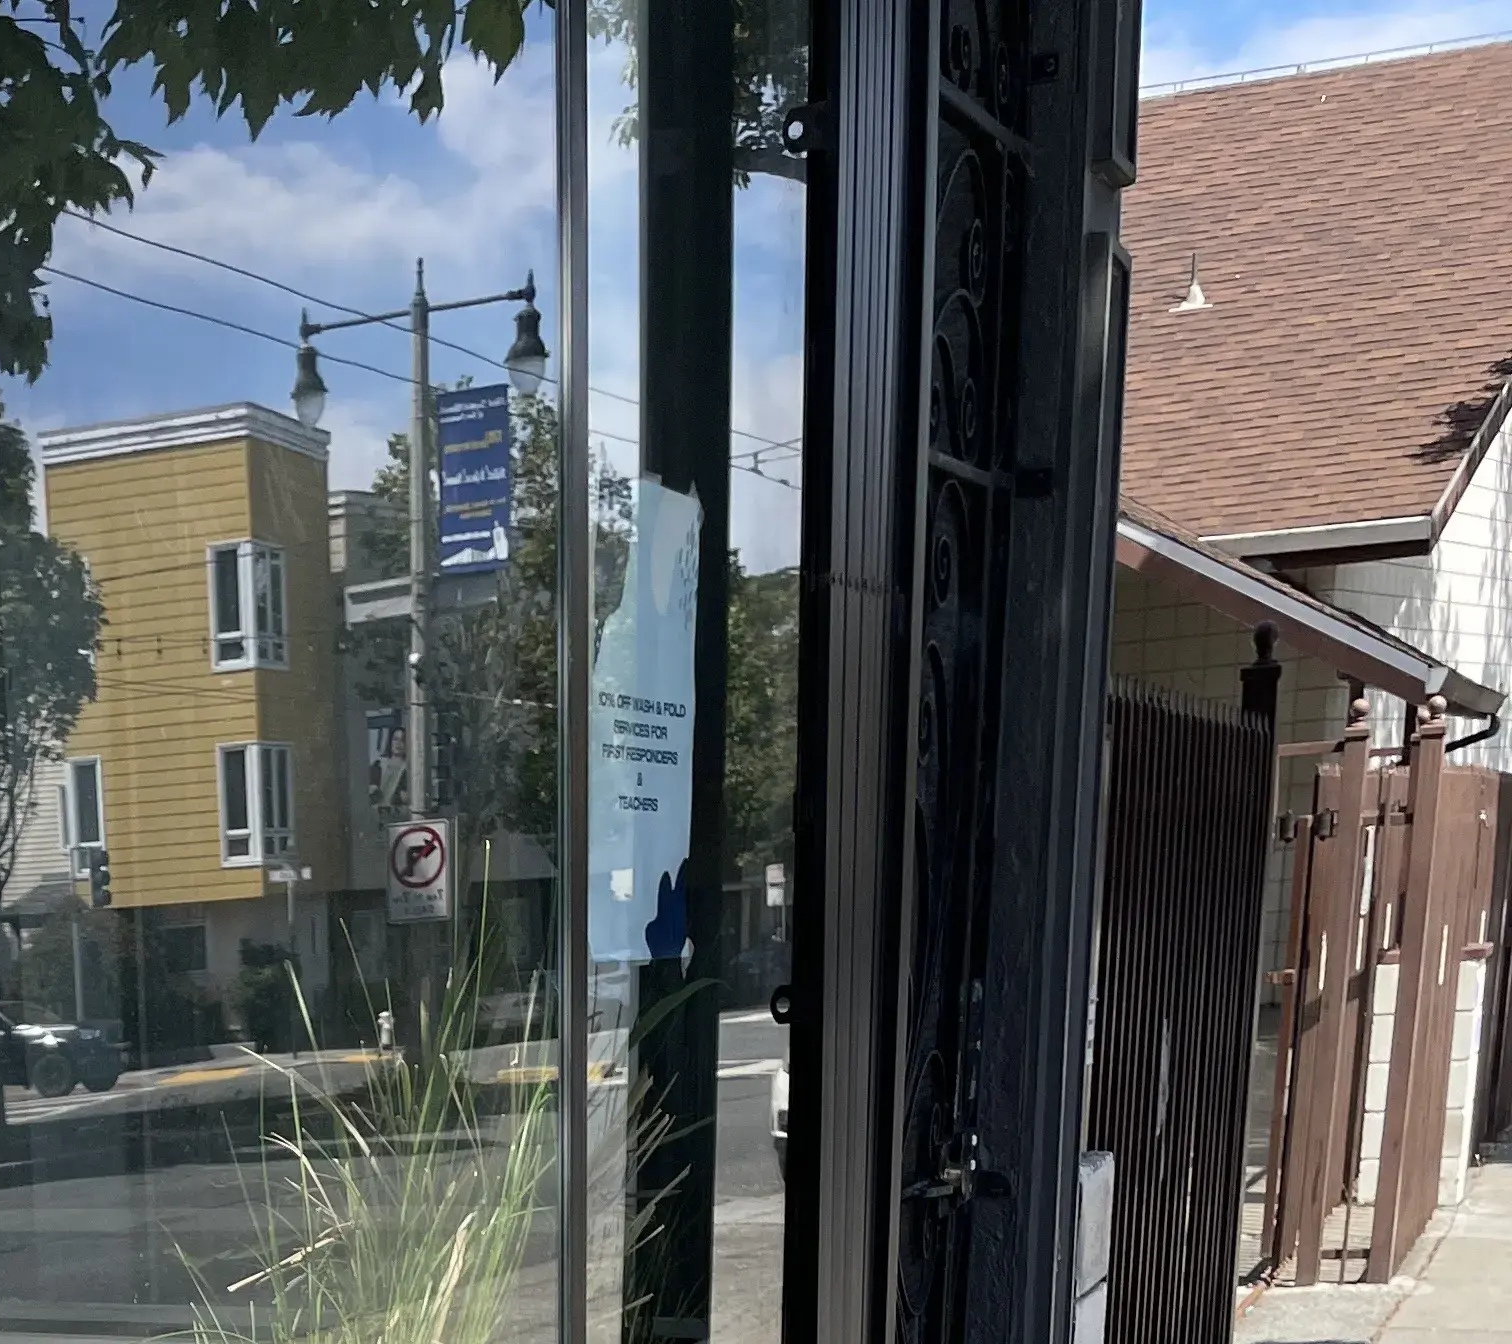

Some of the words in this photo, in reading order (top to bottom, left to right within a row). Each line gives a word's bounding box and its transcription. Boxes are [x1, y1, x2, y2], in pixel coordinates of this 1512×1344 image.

[616, 694, 631, 710] OFF
[632, 697, 655, 714] WASH
[655, 699, 662, 715] &
[663, 702, 687, 718] FOLD
[613, 719, 650, 738] SERVICES
[651, 724, 668, 740] FOR
[601, 743, 625, 760] FIRST
[625, 746, 679, 766] RESPONDERS
[618, 795, 659, 812] TEACHERS
